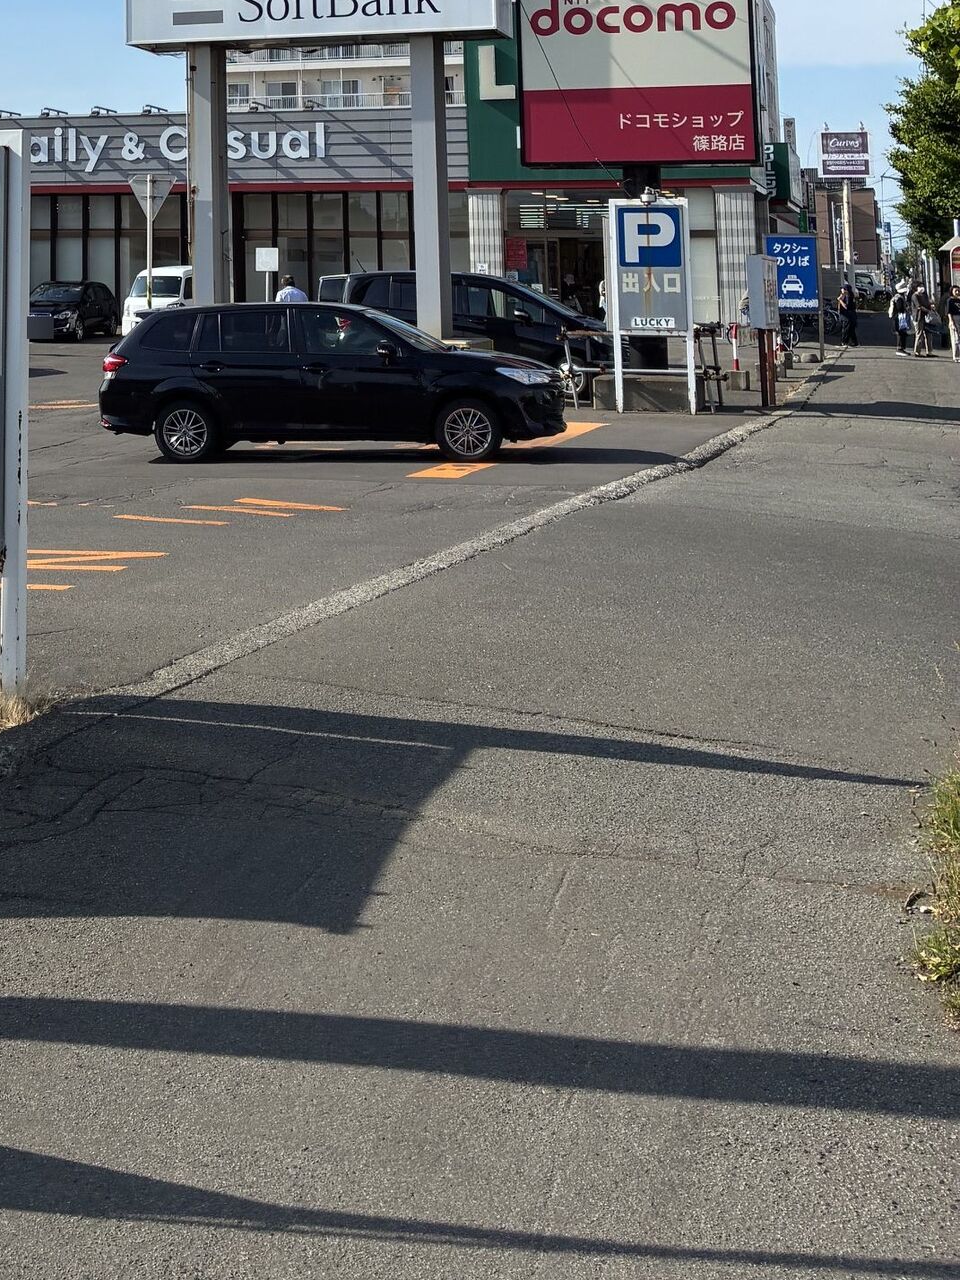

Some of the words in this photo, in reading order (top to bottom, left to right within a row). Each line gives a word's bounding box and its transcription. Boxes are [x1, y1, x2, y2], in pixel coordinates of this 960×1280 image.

[618, 110, 744, 129] ドコモショップ
[30, 127, 109, 172] aily
[121, 132, 145, 161] &
[159, 122, 326, 161] Csual
[692, 134, 745, 152] 篠路店
[623, 212, 676, 263] P
[773, 243, 808, 253] タクシー
[777, 256, 809, 266] のりば
[622, 272, 681, 293] 出入口
[634, 318, 671, 327] LUCKY
